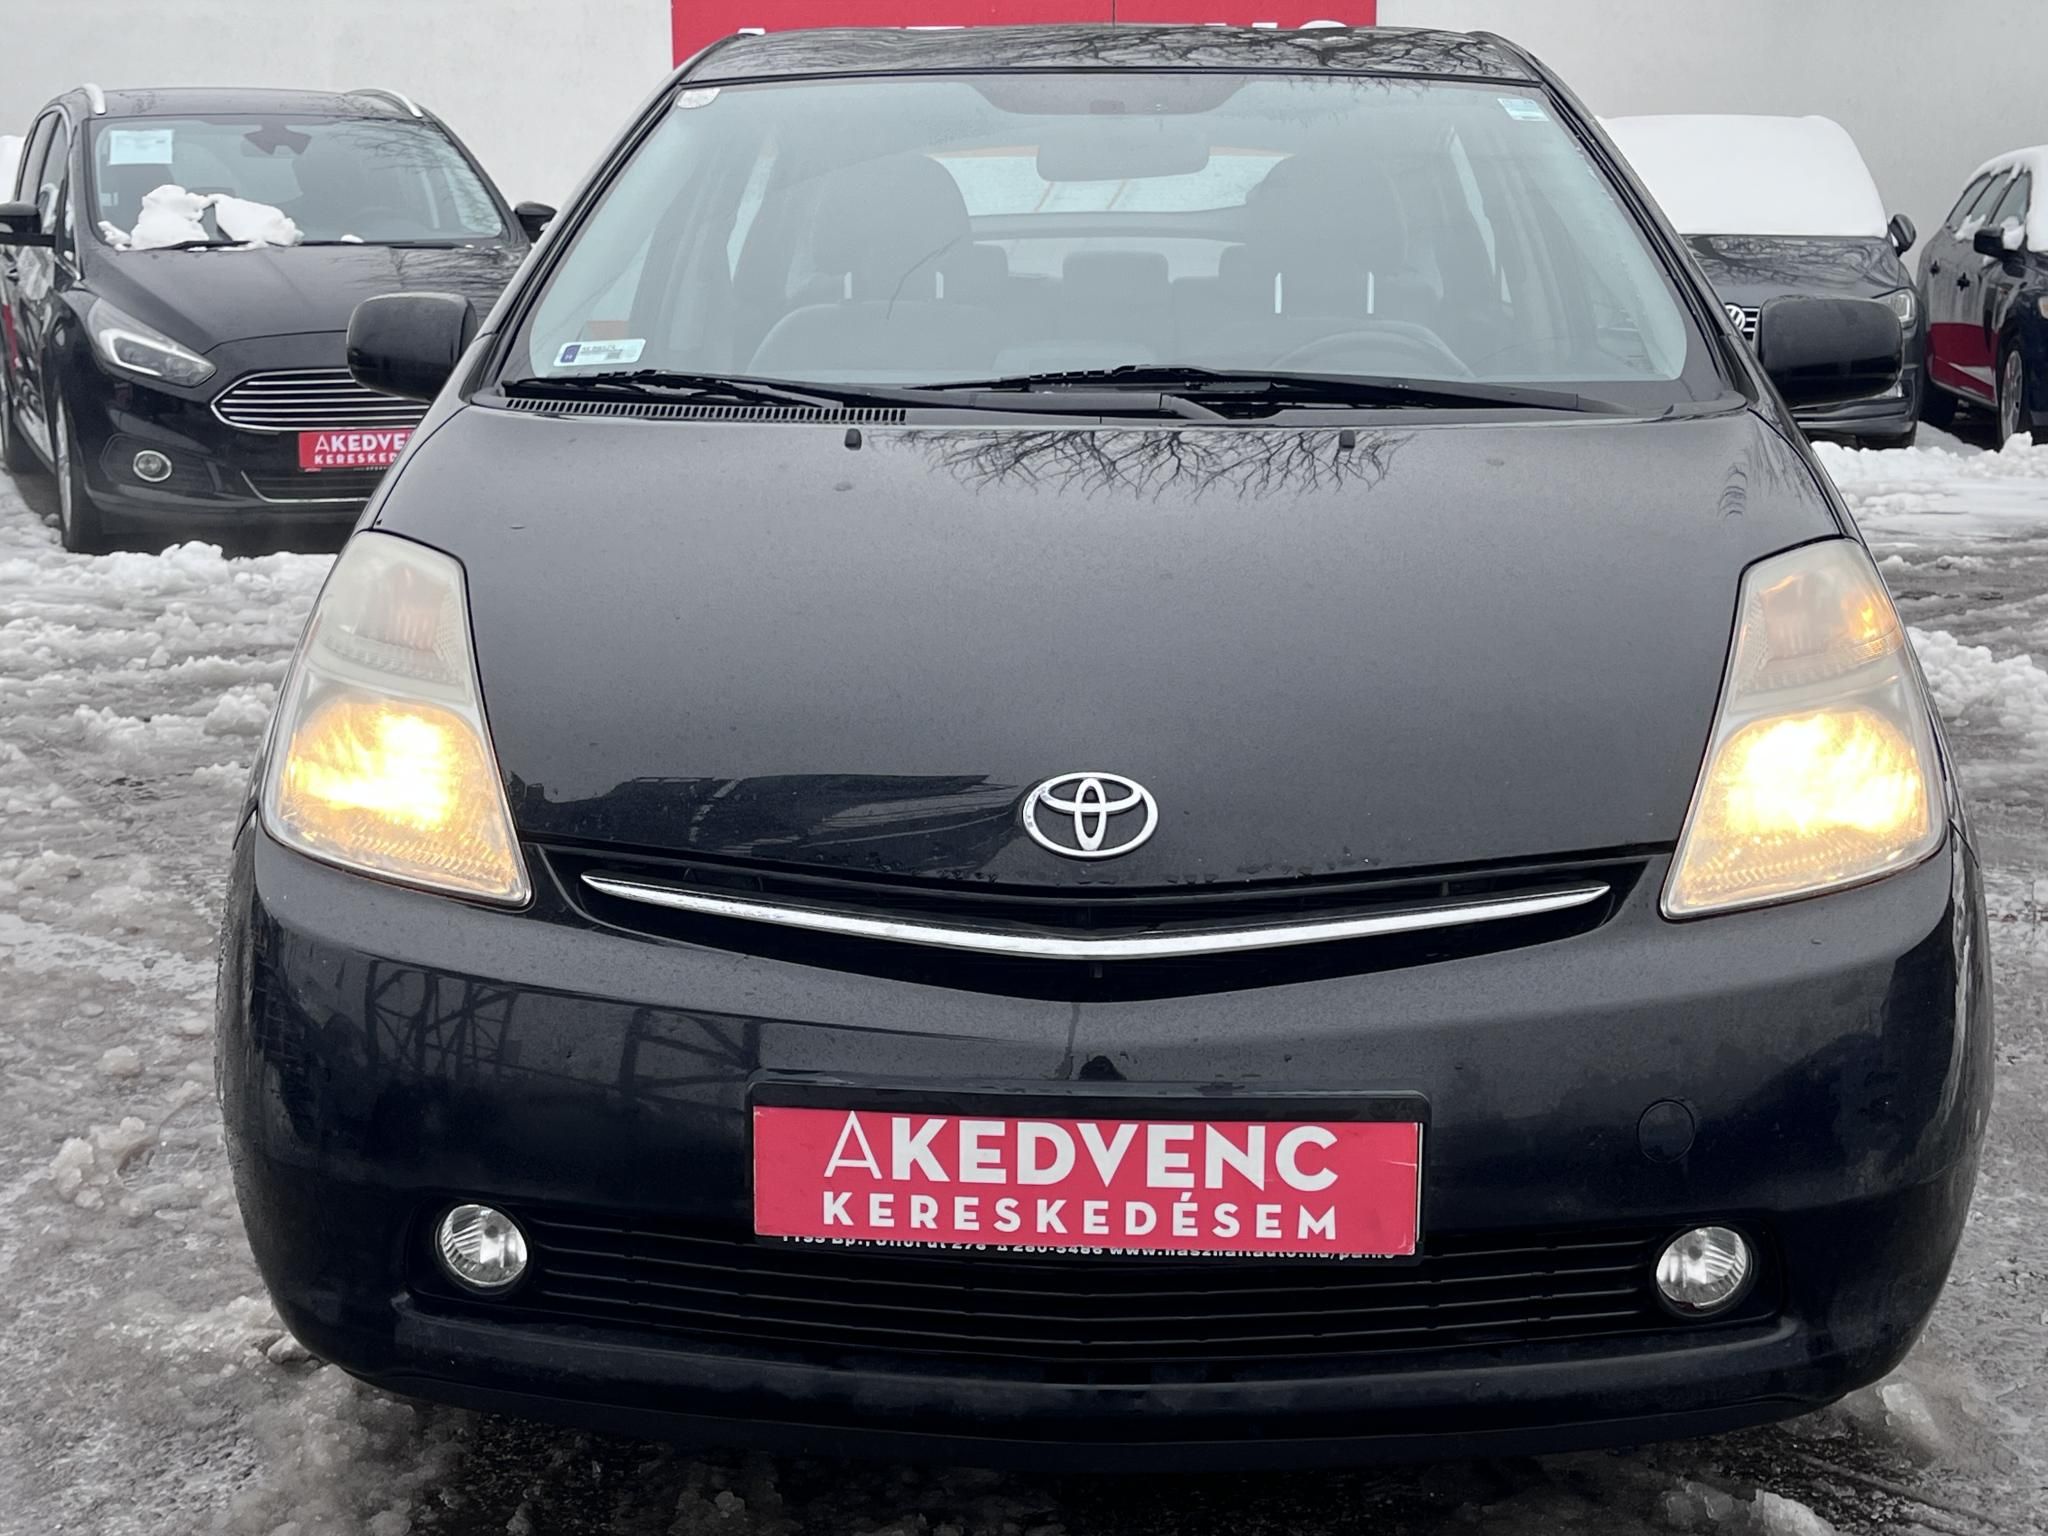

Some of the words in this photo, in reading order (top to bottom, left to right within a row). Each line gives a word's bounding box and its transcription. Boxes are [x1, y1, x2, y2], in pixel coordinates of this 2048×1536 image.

[314, 433, 411, 453] AKEDVE
[823, 1110, 1338, 1193] AKEDVENC
[822, 1192, 1336, 1241] KERESKEDÉSEM
